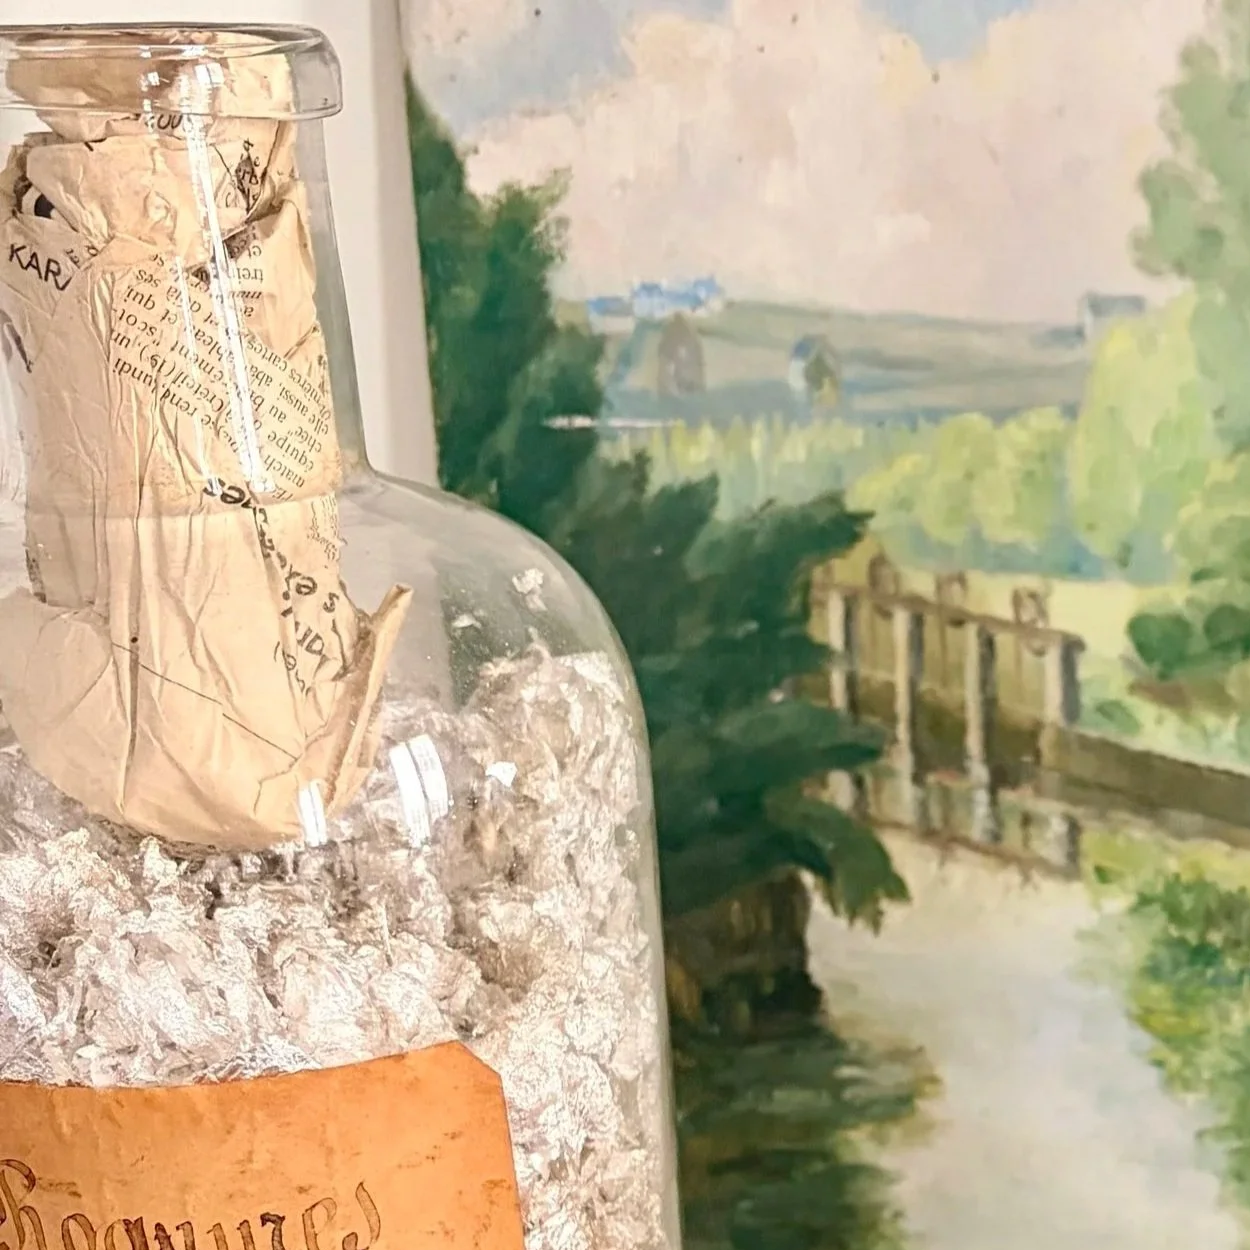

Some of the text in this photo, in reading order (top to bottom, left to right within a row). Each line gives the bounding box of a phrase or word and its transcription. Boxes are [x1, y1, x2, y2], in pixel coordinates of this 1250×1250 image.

[269, 405, 287, 423] au
[277, 383, 308, 416] aussi,
[267, 430, 314, 473] équipe
[264, 455, 305, 488] match
